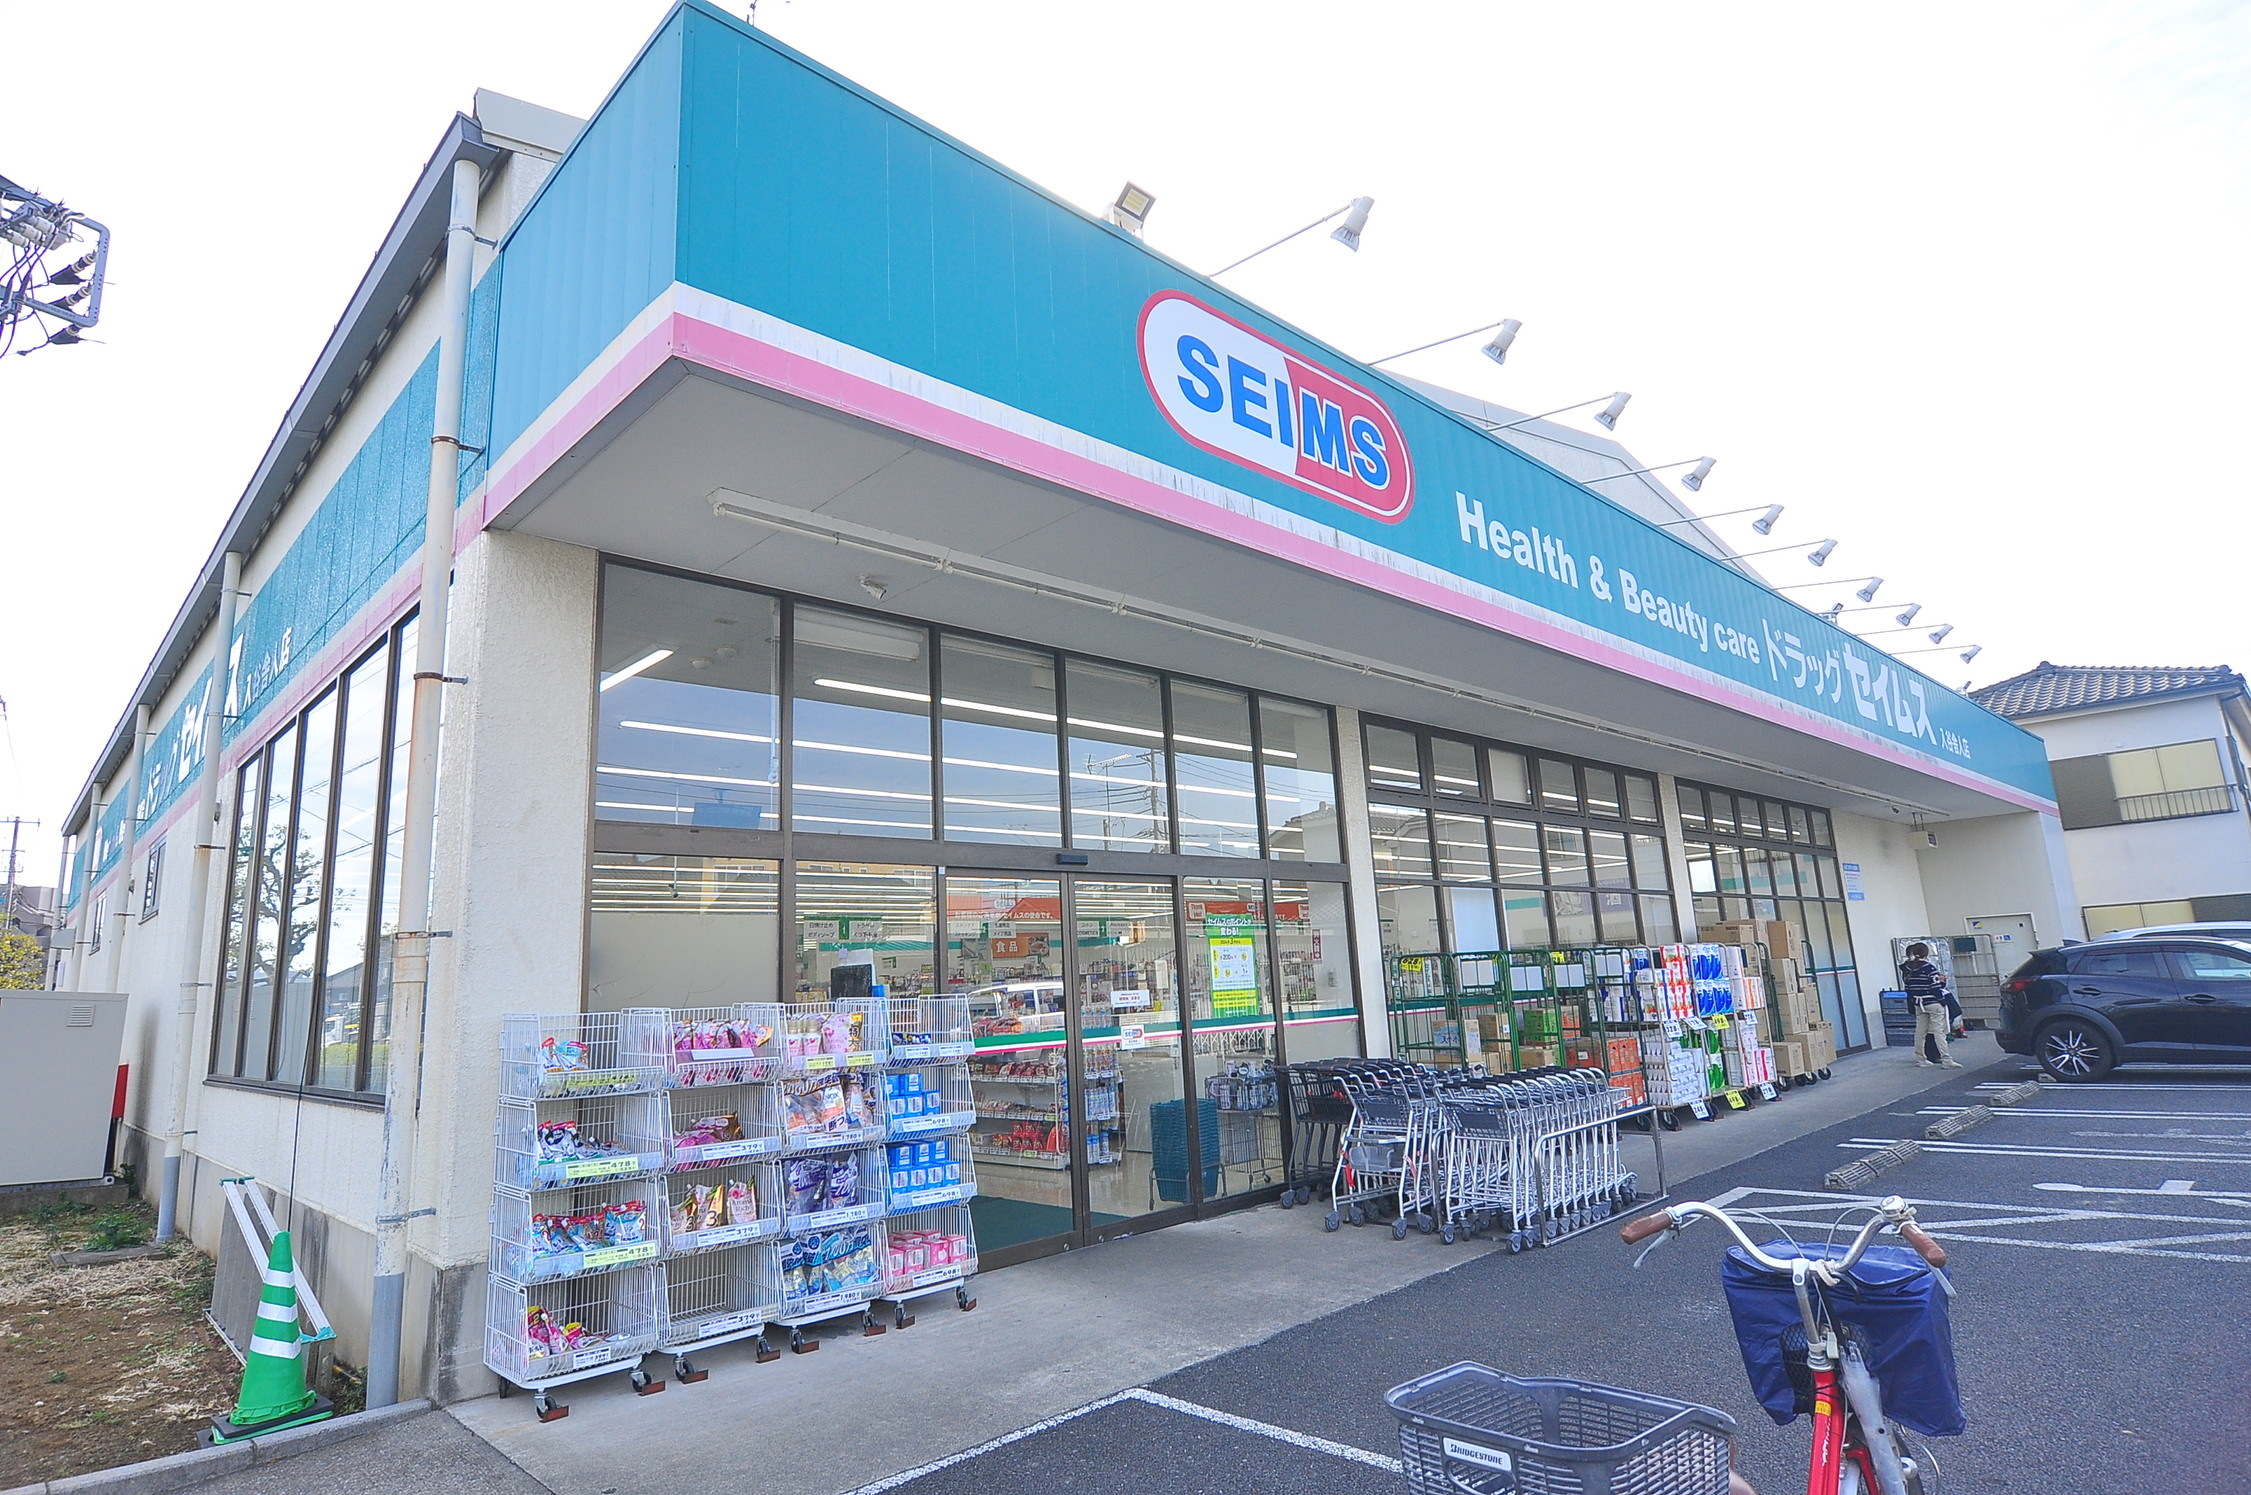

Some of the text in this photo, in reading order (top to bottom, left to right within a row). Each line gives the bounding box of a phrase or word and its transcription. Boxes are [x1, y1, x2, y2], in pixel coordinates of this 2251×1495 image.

[1177, 335, 1390, 489] SEIMS
[1455, 491, 1760, 664] Health & Beauty care
[1939, 727, 1971, 759] 入谷舎人店
[1606, 893, 1622, 905] 酒
[996, 940, 1018, 953] 食品
[685, 1215, 696, 1233] 3
[706, 1210, 719, 1227] 3
[1450, 1443, 1503, 1465] BRIDGESTONE
